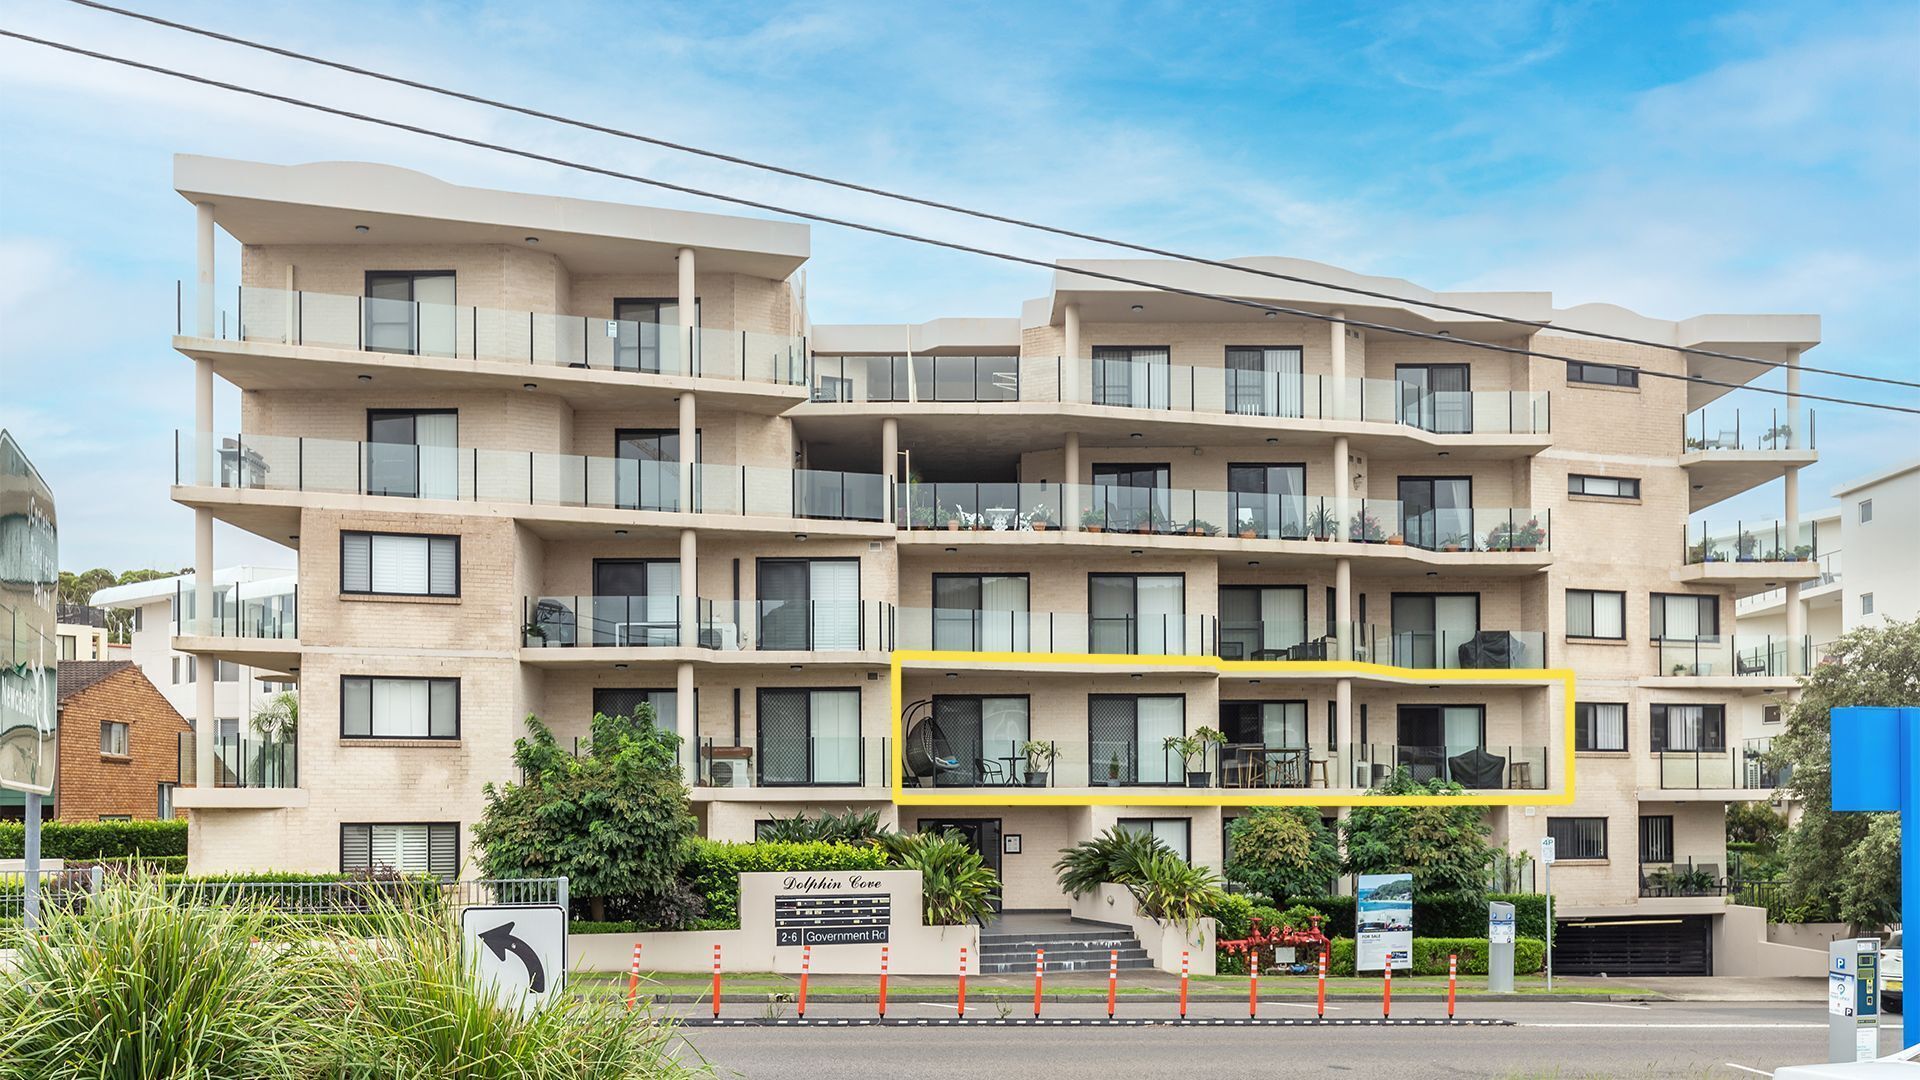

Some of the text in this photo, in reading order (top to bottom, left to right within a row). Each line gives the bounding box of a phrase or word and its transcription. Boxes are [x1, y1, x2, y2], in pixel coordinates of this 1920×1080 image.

[2, 675, 35, 718] Newcastle
[783, 875, 882, 893] Dolphin Cove
[781, 930, 886, 942] 2-6 Government Rd
[1837, 958, 1844, 968] P
